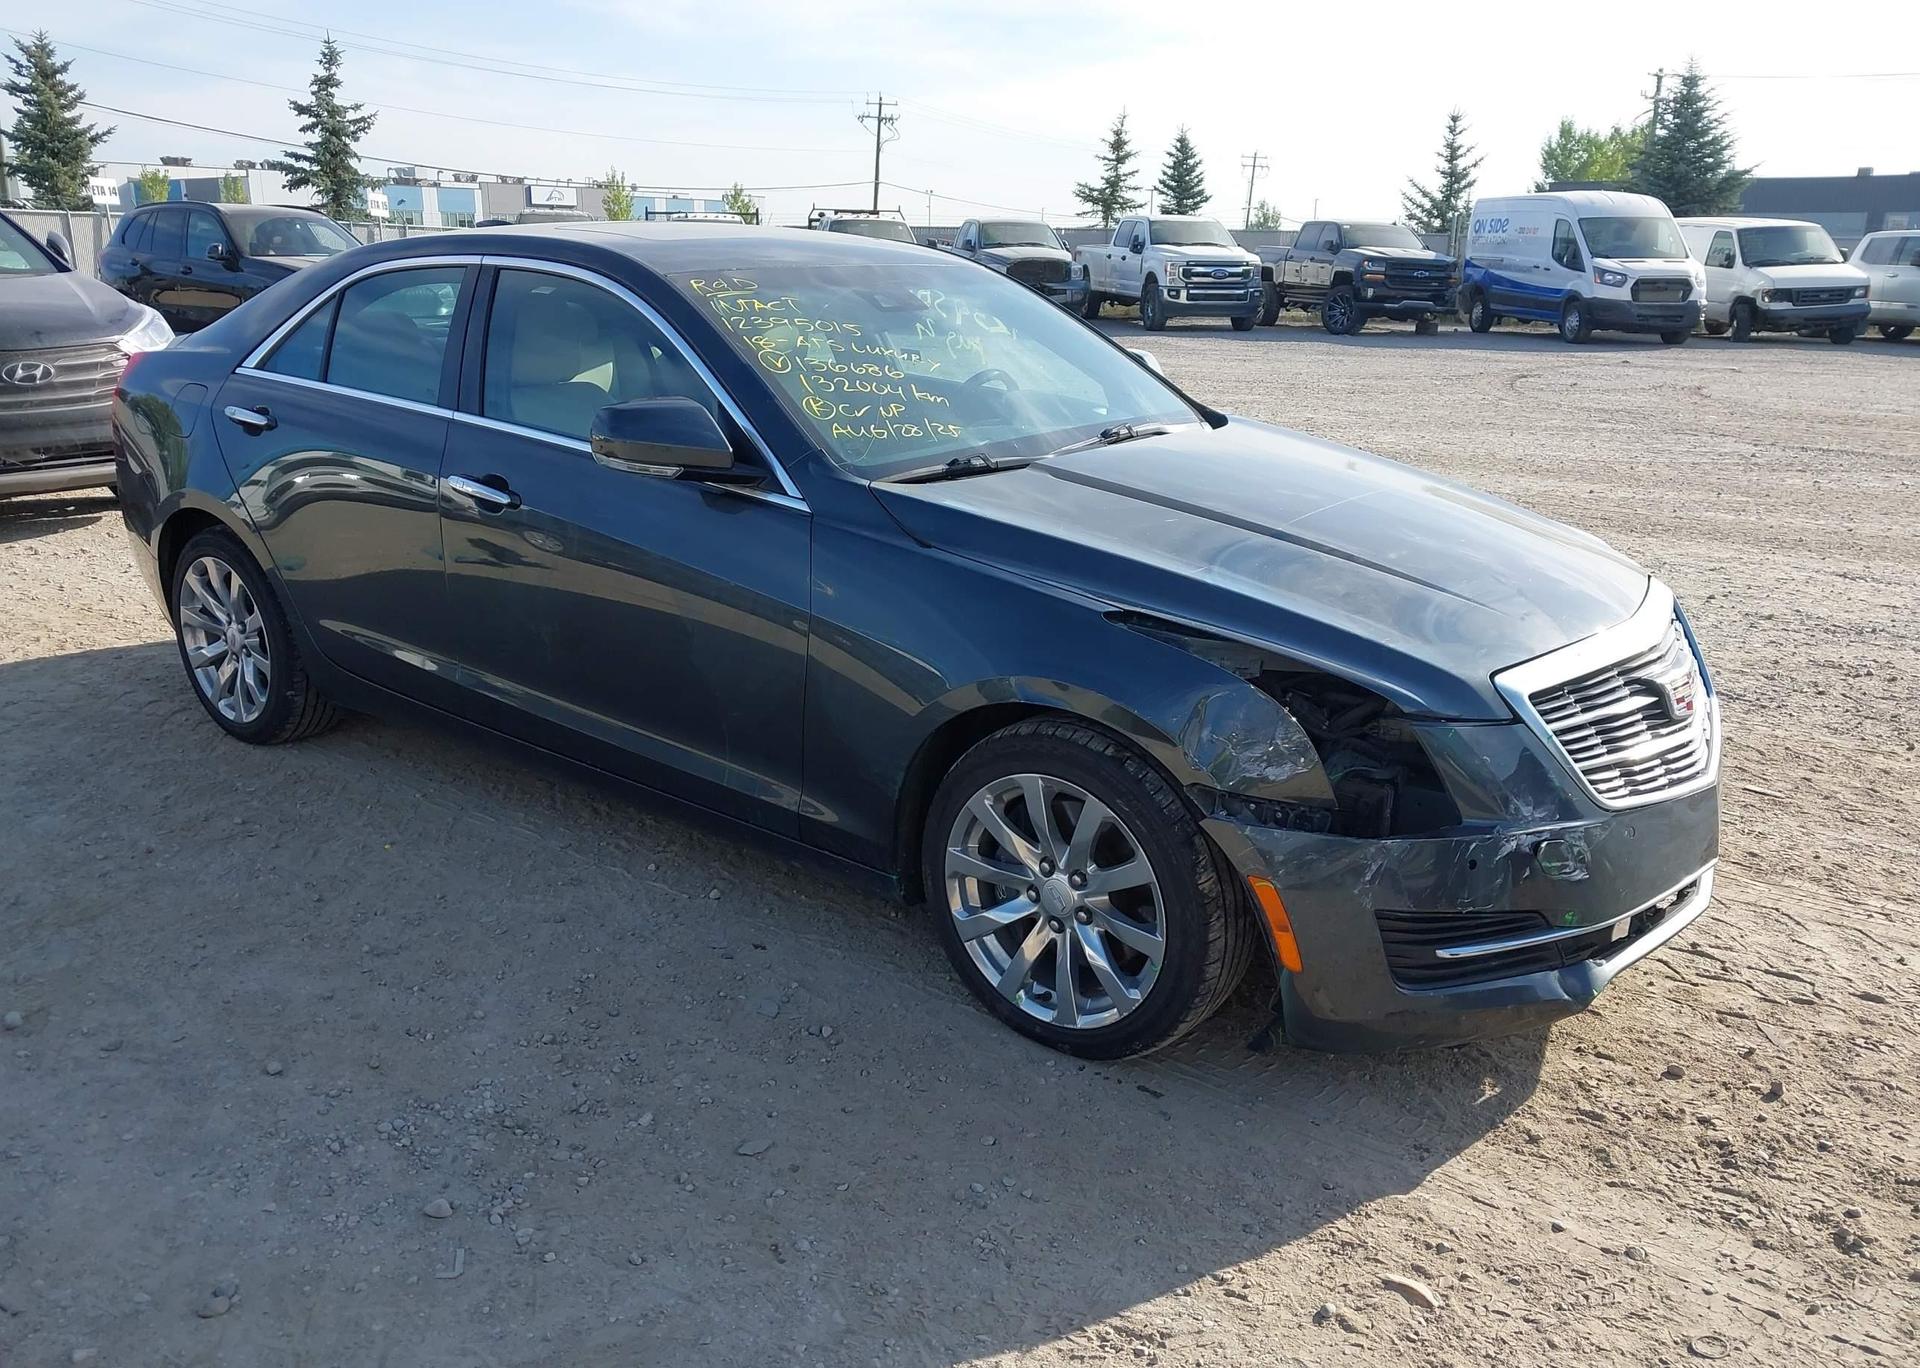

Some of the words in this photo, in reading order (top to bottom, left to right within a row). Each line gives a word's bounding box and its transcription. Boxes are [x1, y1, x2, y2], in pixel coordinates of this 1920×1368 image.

[1474, 218, 1488, 234] ON
[710, 296, 801, 315] INTACT
[721, 316, 862, 336] 12395015
[796, 335, 845, 352] ATS
[795, 356, 905, 379] 136686
[800, 374, 907, 402] 132004
